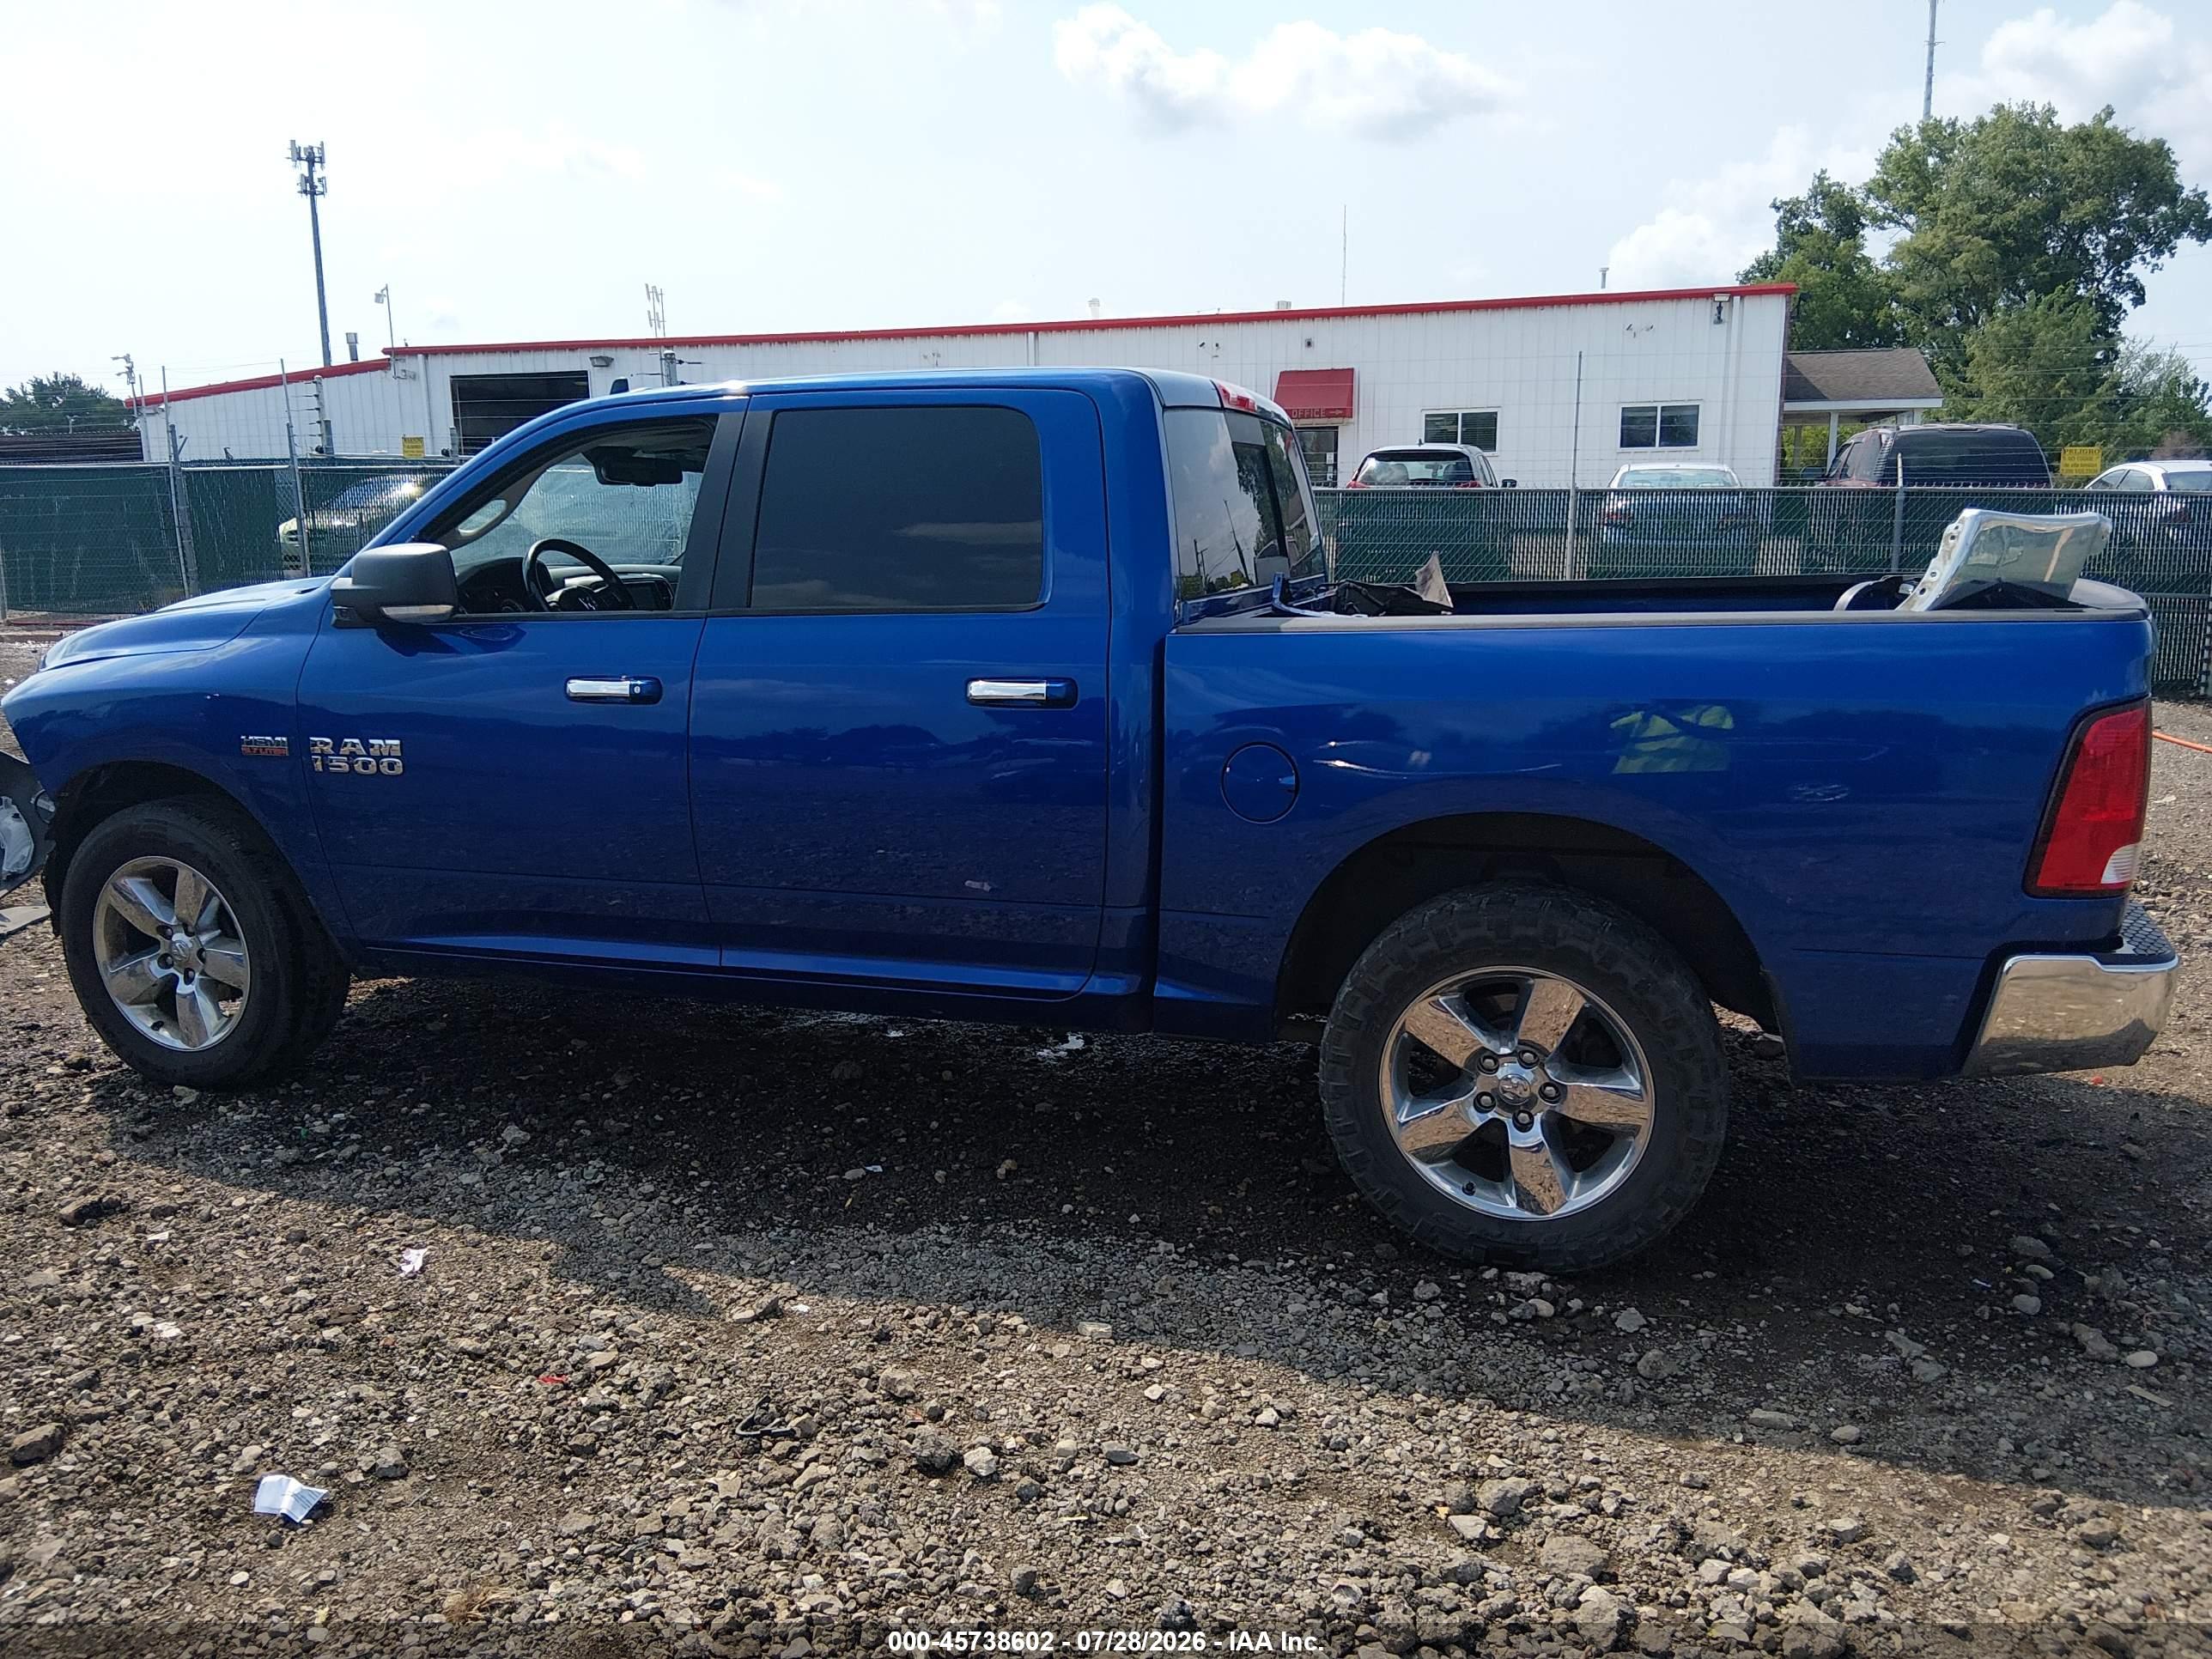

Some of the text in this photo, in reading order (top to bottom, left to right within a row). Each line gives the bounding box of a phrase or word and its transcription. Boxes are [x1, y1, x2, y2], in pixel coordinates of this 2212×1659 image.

[1291, 409, 1326, 418] OFFICE
[309, 737, 401, 756] RAM
[311, 756, 404, 775] 1500
